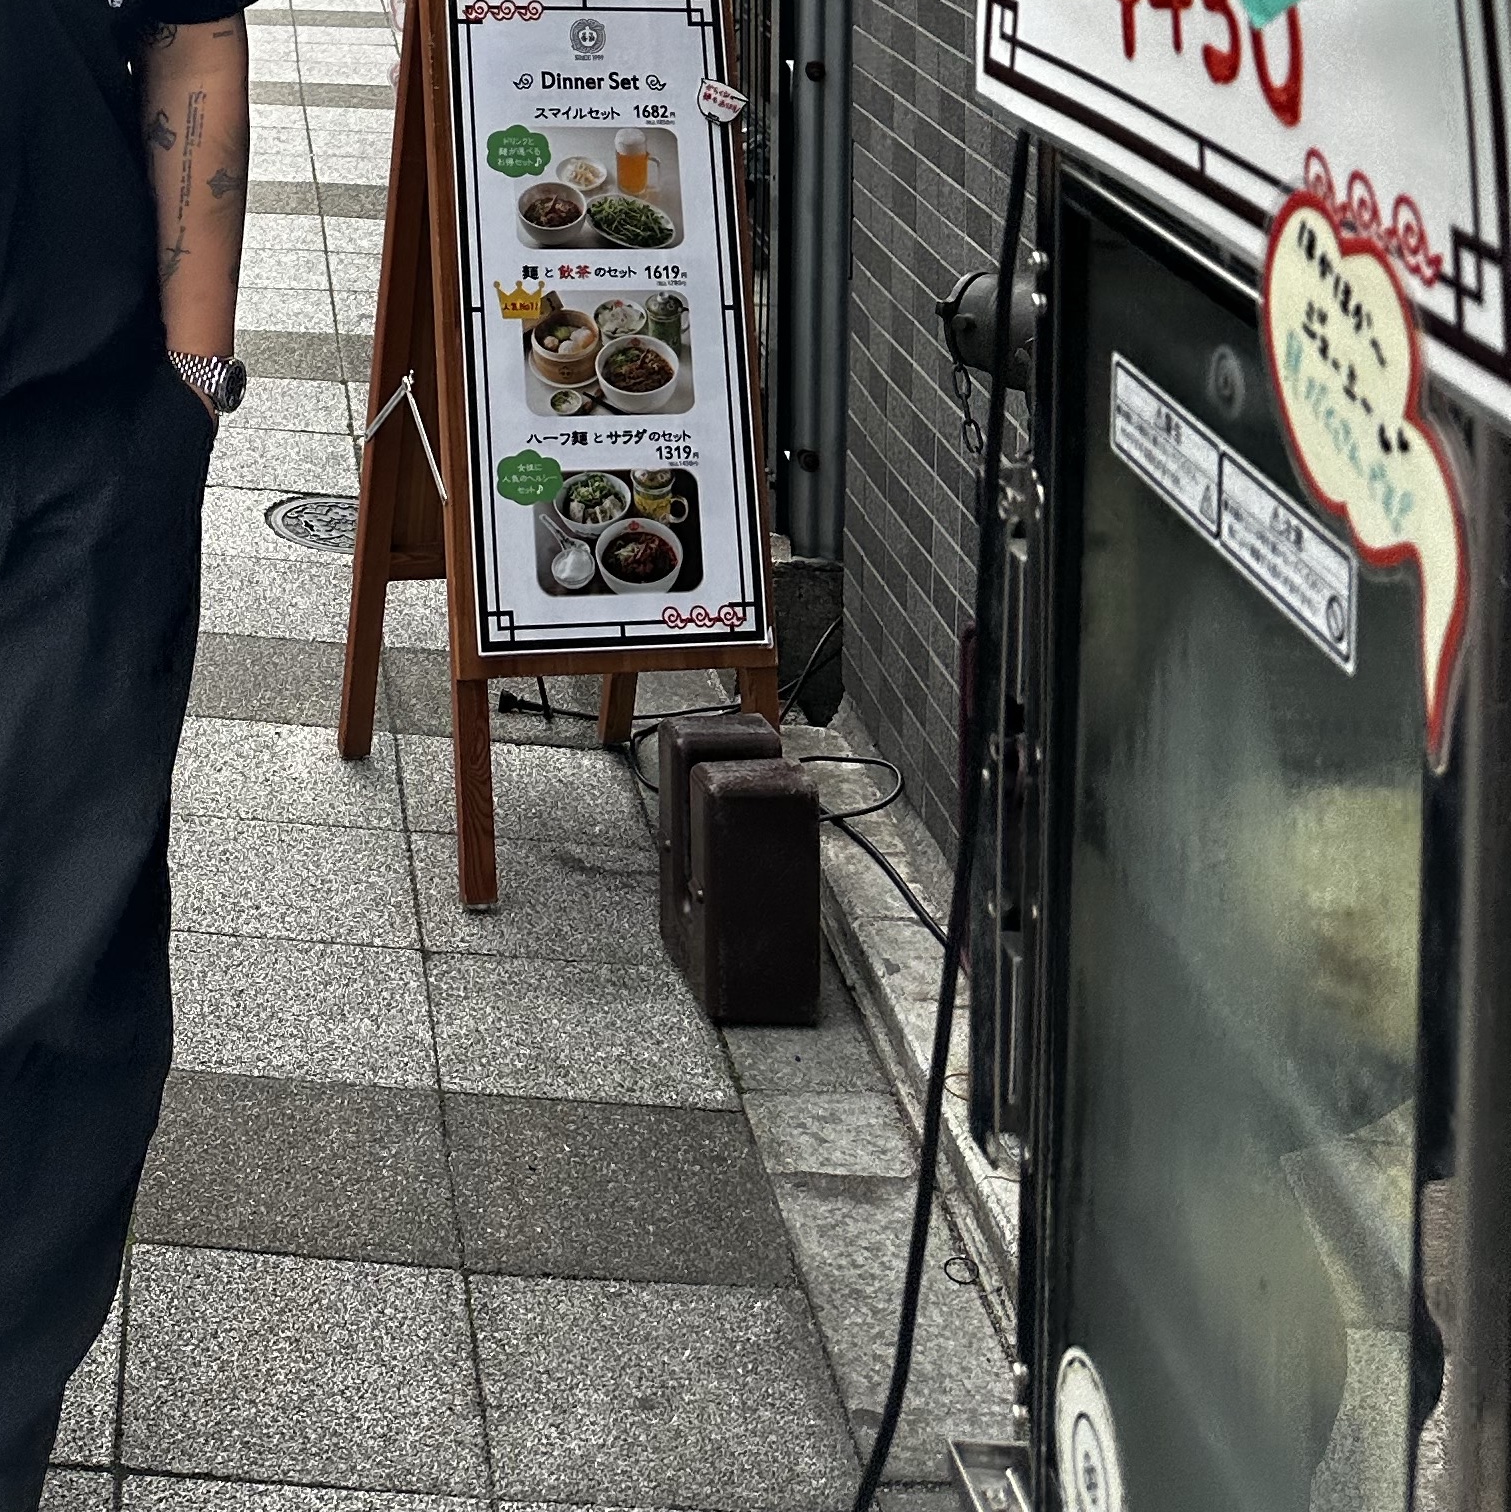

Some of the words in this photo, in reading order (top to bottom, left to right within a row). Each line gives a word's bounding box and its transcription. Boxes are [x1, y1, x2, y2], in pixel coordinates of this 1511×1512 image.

[541, 71, 605, 90] Dinner
[608, 71, 640, 91] Set
[534, 106, 621, 121] スマイルセット
